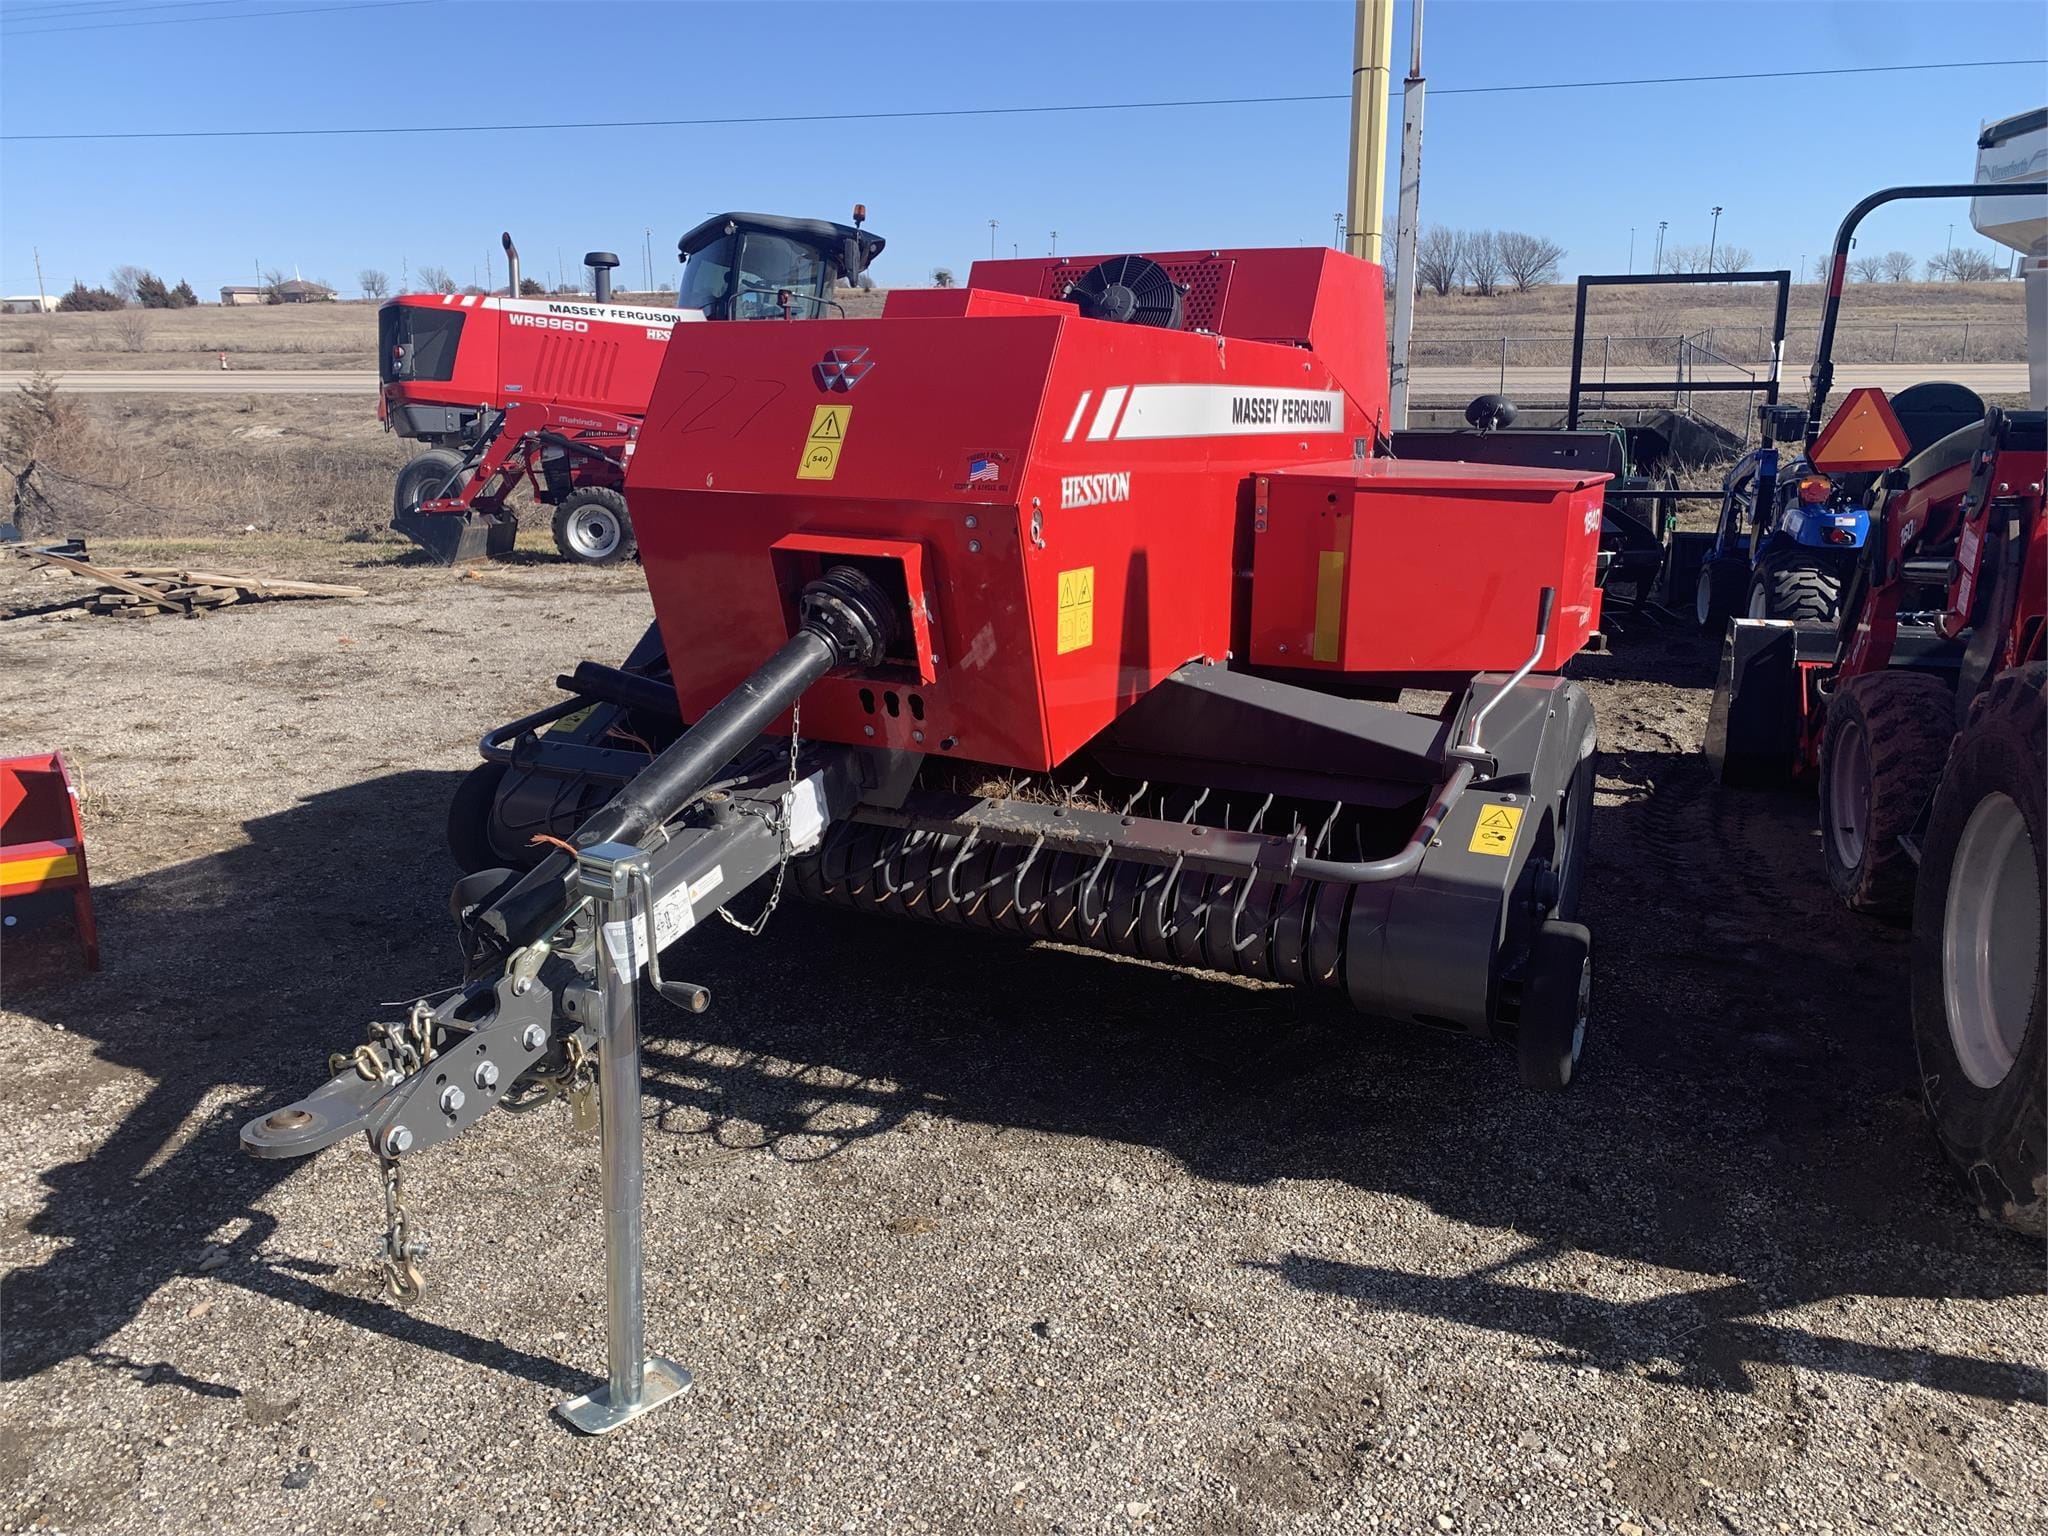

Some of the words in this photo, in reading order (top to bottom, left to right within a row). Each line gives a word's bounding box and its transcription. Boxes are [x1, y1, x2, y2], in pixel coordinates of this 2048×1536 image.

[509, 313, 589, 333] WR9960
[549, 304, 606, 317] MASSEY
[611, 309, 682, 323] FERGUSON
[1232, 396, 1279, 425] MASSEY
[1281, 398, 1332, 424] FERGUSON
[559, 415, 603, 428] Mahindra
[811, 454, 828, 464] 540
[1060, 471, 1131, 509] HESSTON
